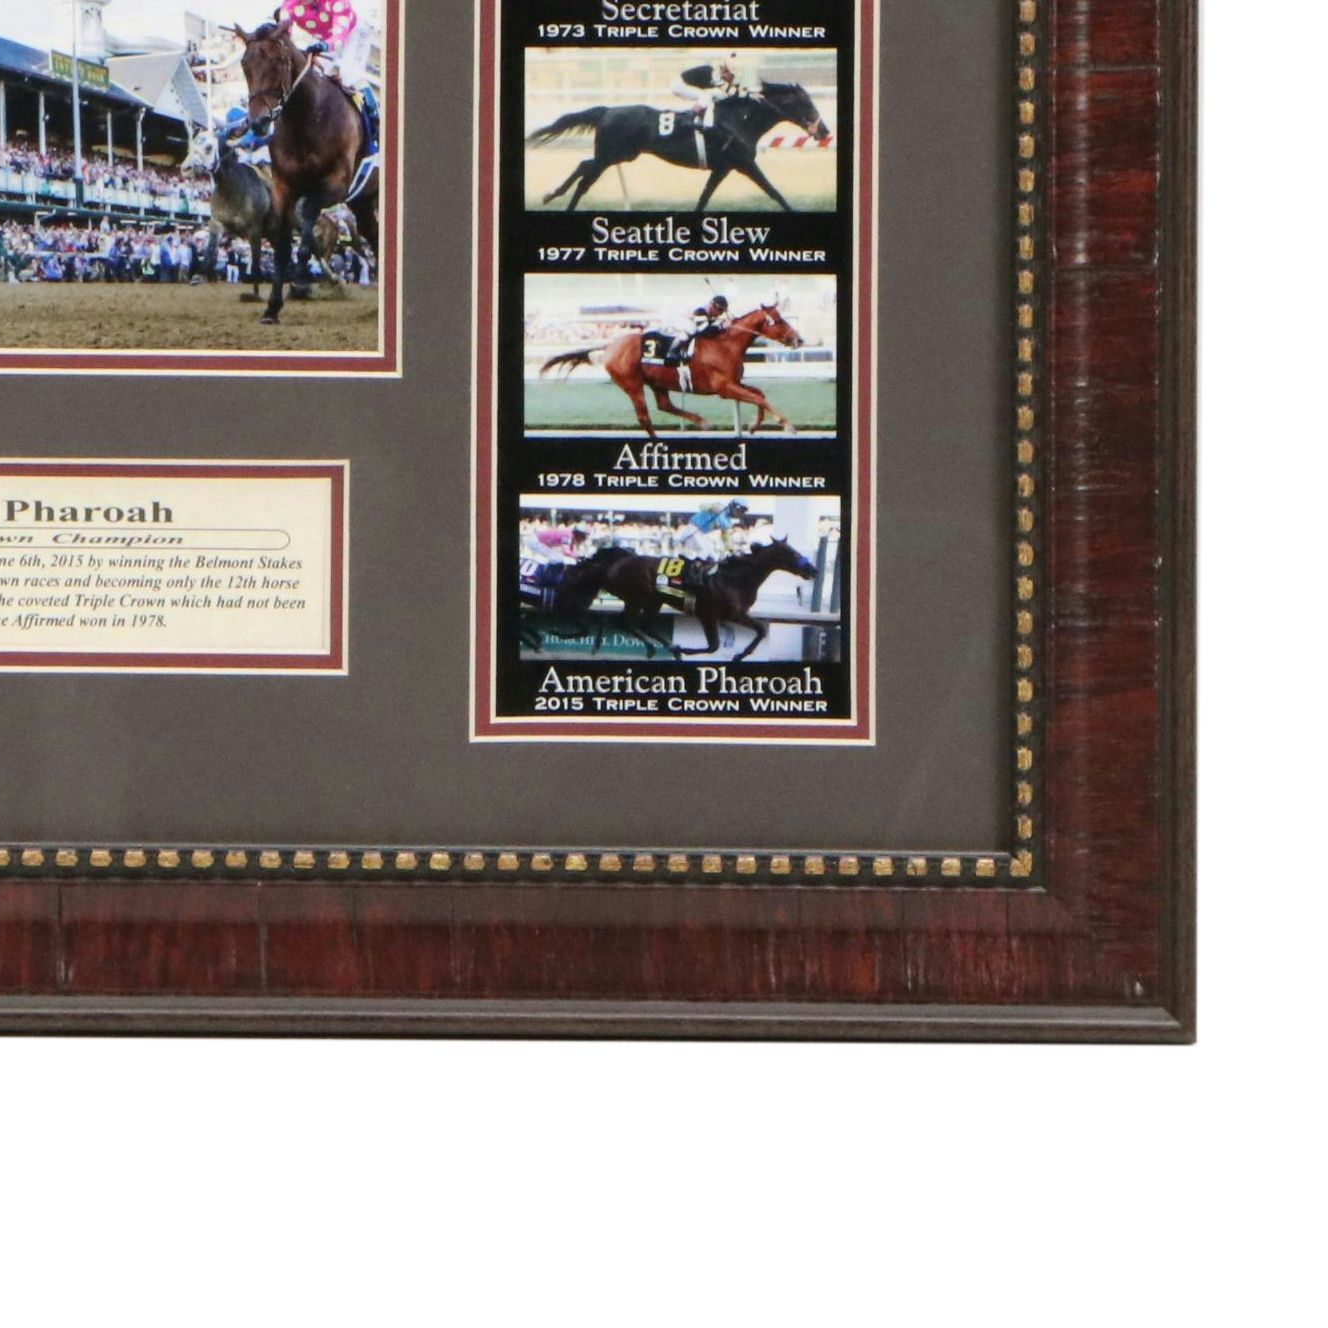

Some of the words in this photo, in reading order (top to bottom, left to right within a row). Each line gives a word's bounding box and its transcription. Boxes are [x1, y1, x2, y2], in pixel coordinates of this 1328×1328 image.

[538, 23, 585, 37] 1973
[658, 112, 675, 136] 8
[592, 216, 690, 244] Seattle
[701, 216, 770, 244] Slew
[538, 247, 586, 261] 1977
[643, 339, 657, 358] 3
[613, 442, 747, 471] Affirmed
[538, 473, 585, 487] 1978
[6, 500, 172, 523] Pharoah
[52, 533, 183, 546] Champion
[19, 554, 45, 568] 6th,
[50, 554, 83, 567] 2015
[87, 554, 103, 570] by
[108, 555, 165, 571] winning
[168, 555, 191, 568] the
[195, 555, 254, 569] Belmont
[257, 556, 302, 569] Stakes
[656, 558, 685, 577] 18
[17, 594, 70, 607] coveted
[75, 593, 115, 611] Triple
[119, 594, 165, 608] Crown
[170, 594, 211, 608] which
[215, 595, 244, 608] had
[246, 597, 270, 608] not
[273, 595, 306, 609] been
[11, 613, 75, 630] Affirmed
[79, 617, 107, 627] won
[111, 614, 125, 627] in
[131, 614, 167, 627] 1978.
[538, 666, 687, 693] American
[696, 666, 823, 694] Pharoah
[534, 696, 584, 710] 2015
